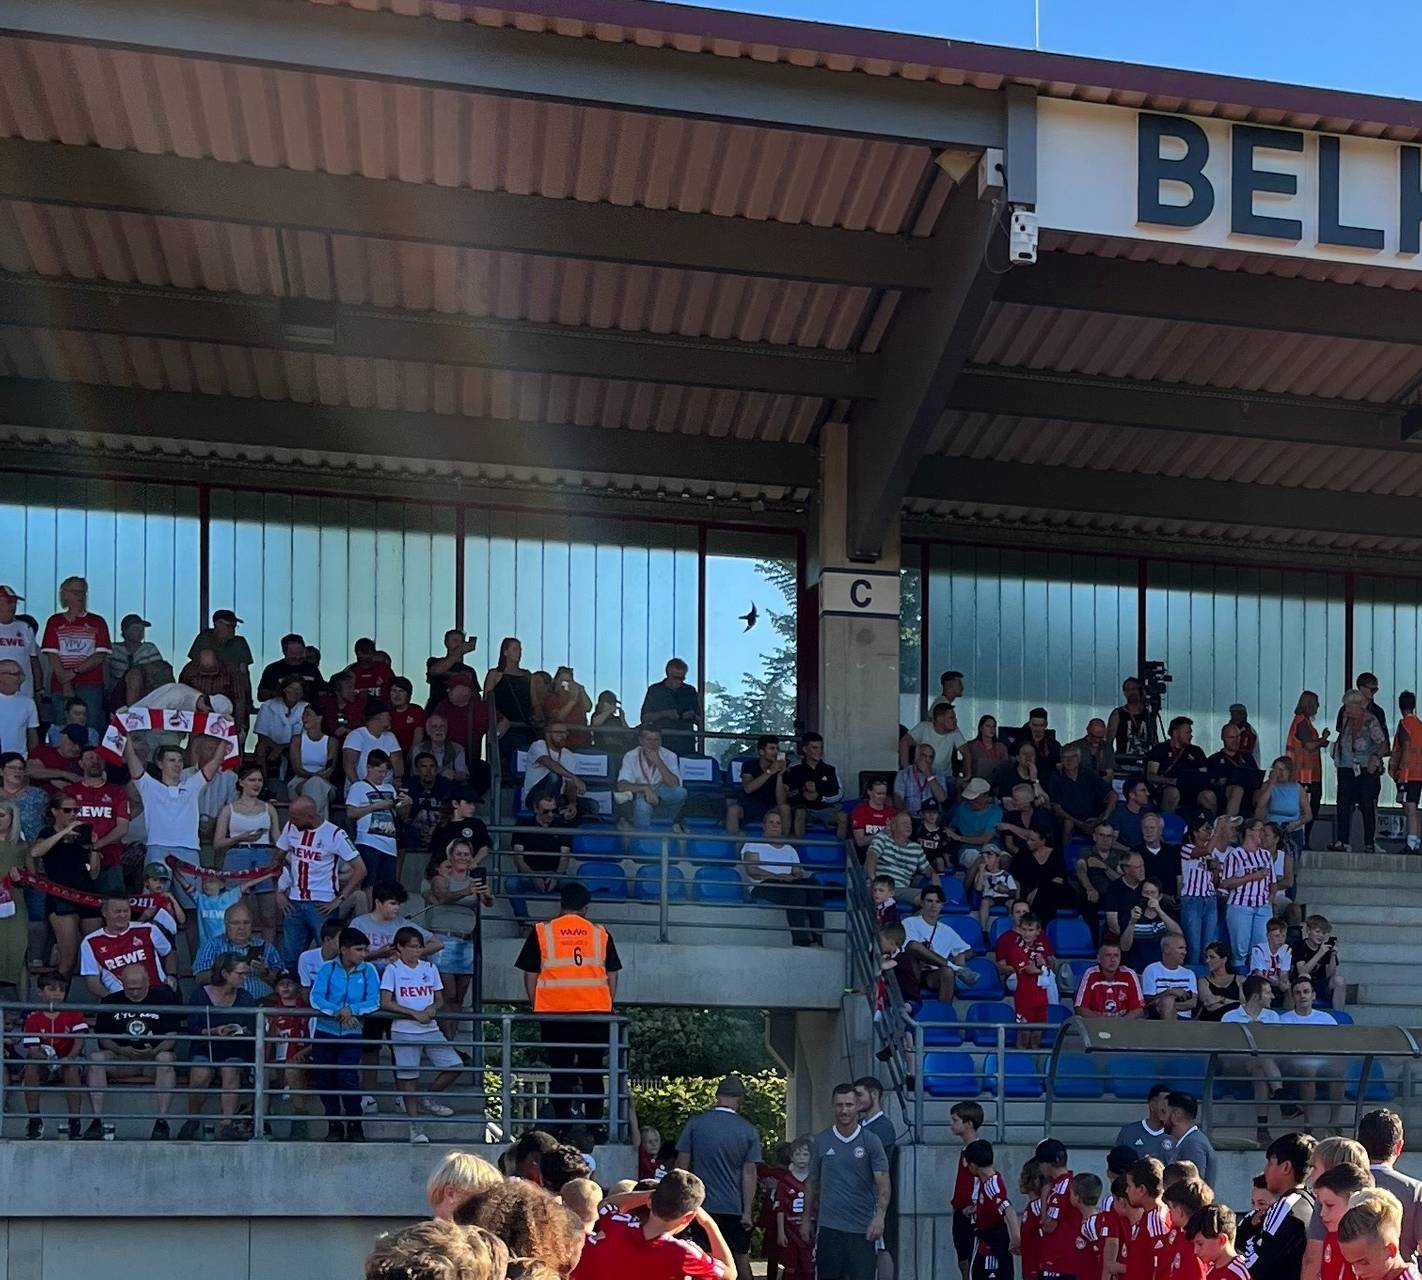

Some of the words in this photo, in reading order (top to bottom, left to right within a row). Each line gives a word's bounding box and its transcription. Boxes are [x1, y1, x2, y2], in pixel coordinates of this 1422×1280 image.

[850, 579, 872, 608] C
[104, 949, 147, 970] REWE
[573, 946, 584, 967] 6
